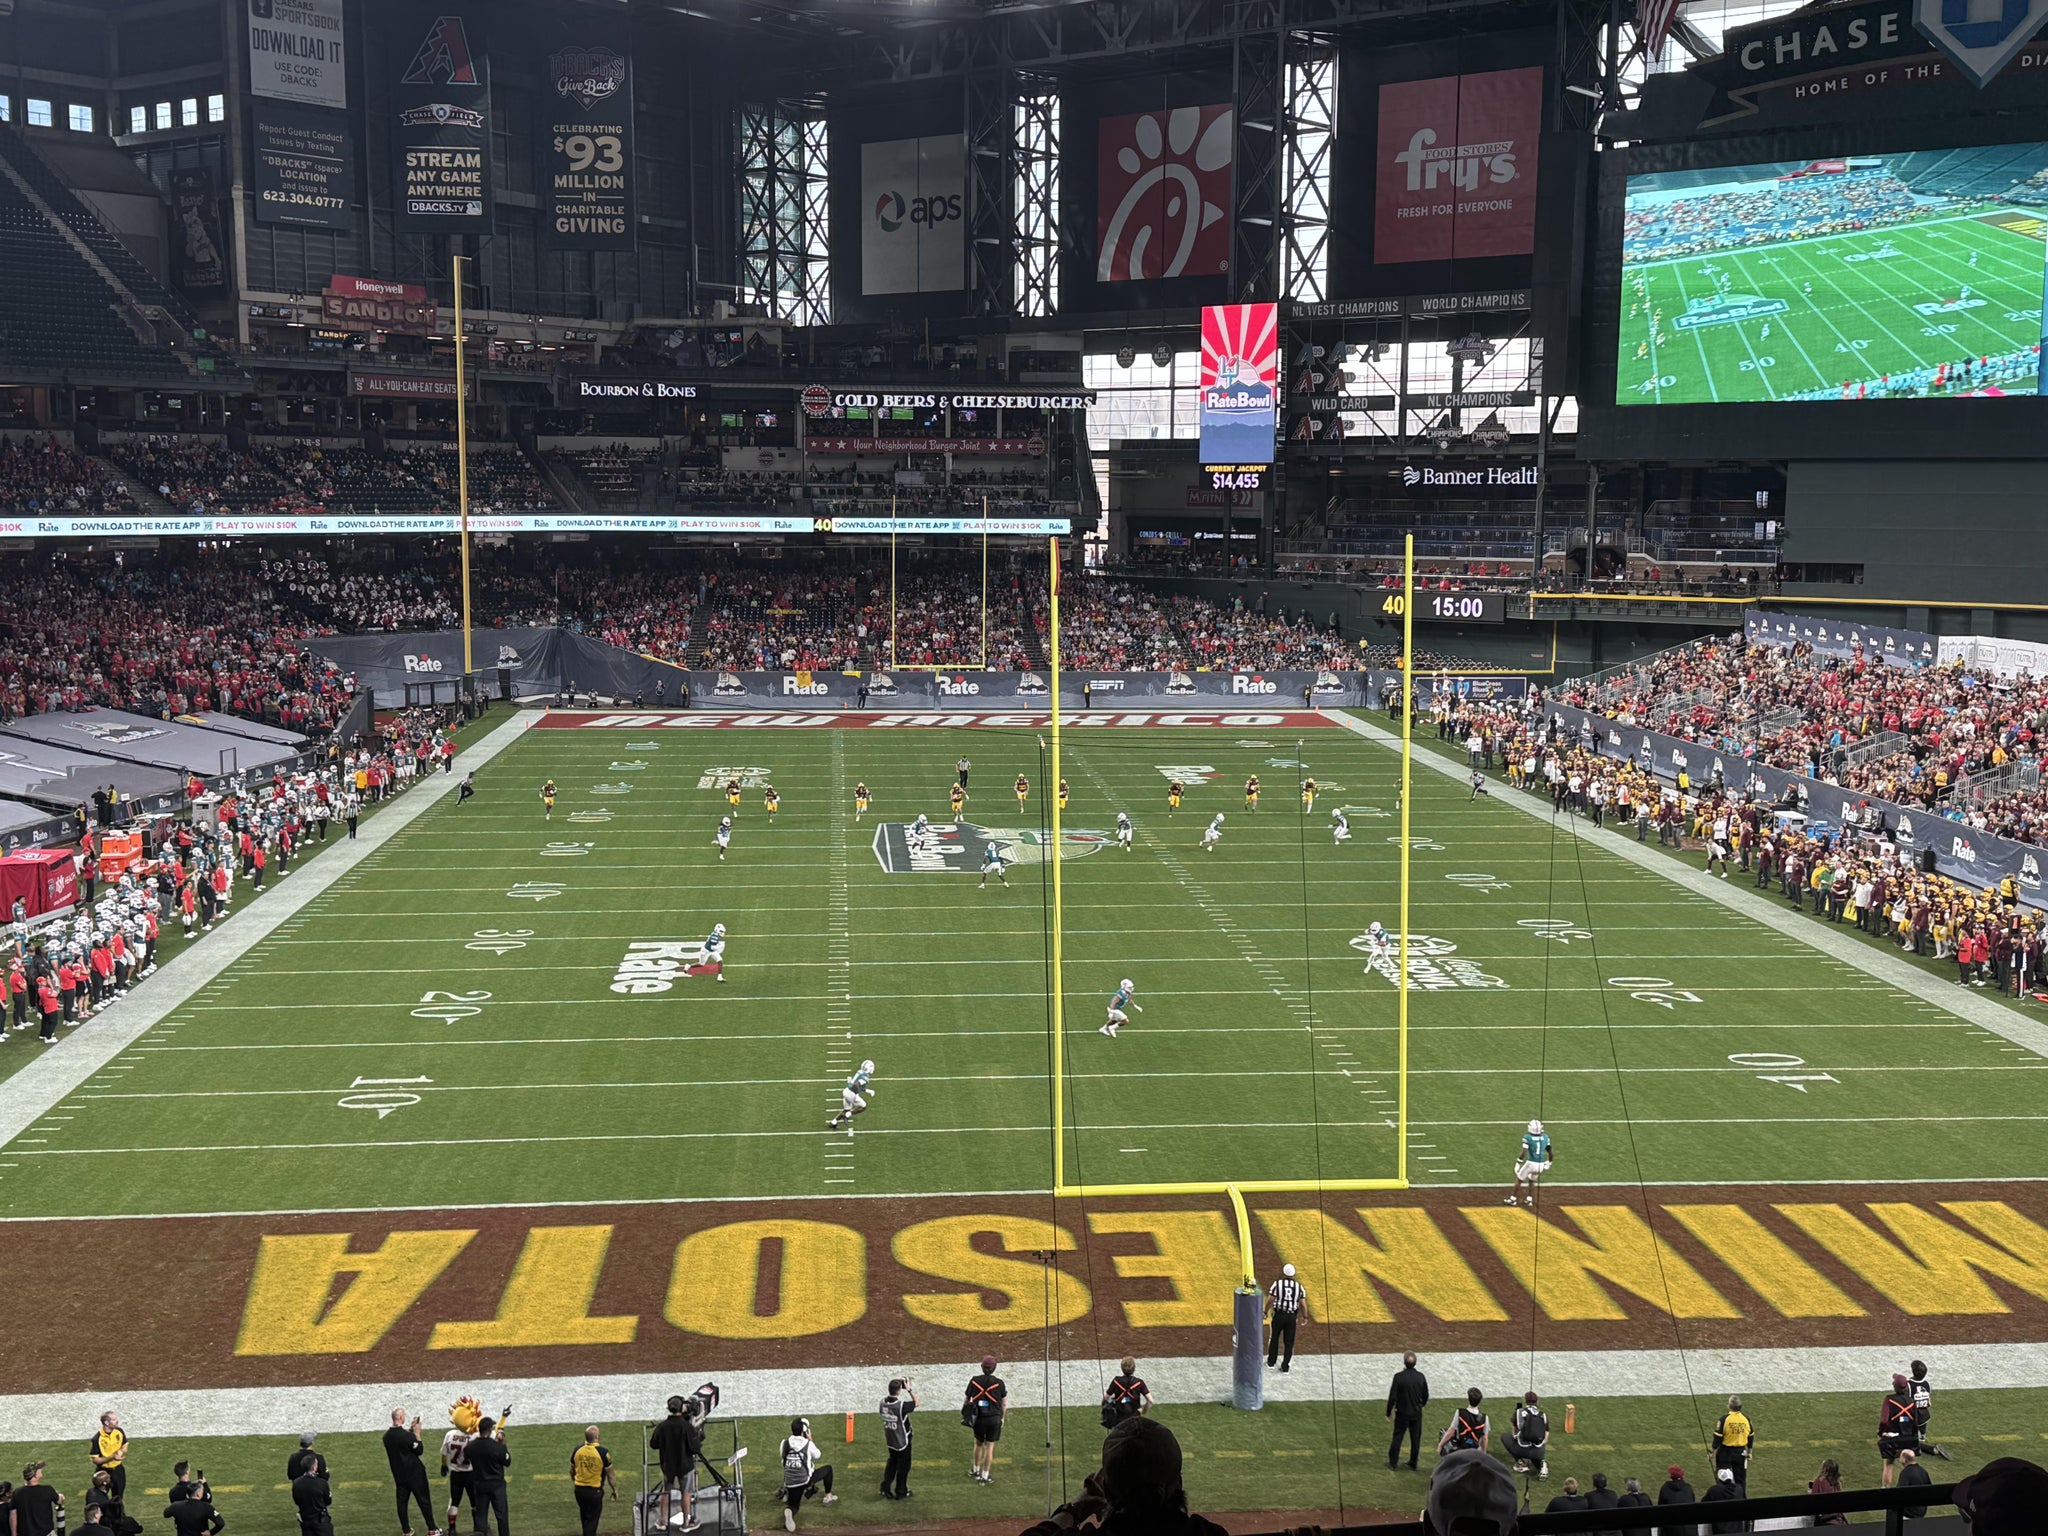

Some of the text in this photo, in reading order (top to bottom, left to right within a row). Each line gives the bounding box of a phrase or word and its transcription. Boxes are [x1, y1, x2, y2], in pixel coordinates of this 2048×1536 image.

[275, 7, 340, 32] SPORTSBOOK
[252, 27, 341, 63] DOWNLOAD IT
[1740, 12, 1900, 71] CHASE
[274, 61, 323, 78] USE CODE:
[280, 73, 318, 88] DBACKS
[557, 76, 618, 97] Give Back
[1795, 64, 1941, 98] HOME OF THE
[409, 111, 474, 120] CHASE FIELD
[259, 123, 343, 143] Report Guest Conduct
[552, 124, 623, 134] CELEBRATING
[269, 136, 335, 154] Issues by Texting
[1425, 143, 1509, 159] FOOD STORES
[406, 152, 481, 168] STREAM
[554, 135, 624, 172] $93
[1395, 128, 1517, 192] fry's
[279, 168, 327, 183] LOCATION
[407, 170, 482, 183] ANY GAME
[554, 174, 625, 189] MILLION
[282, 182, 296, 190] and
[319, 186, 328, 194] to
[407, 185, 482, 197] ANYWHERE
[263, 190, 345, 209] 623.304.0777
[582, 191, 596, 202] IN
[411, 202, 464, 213] DBACKS.TV
[555, 204, 625, 215] CHARITABLE
[910, 194, 962, 229] aps
[1397, 199, 1513, 218] FRESH FOR EVERYONE
[556, 217, 626, 234] GIVING
[355, 280, 404, 294] Honeywell
[1292, 301, 1399, 317] NL WEST CHAMPIONS
[1422, 293, 1525, 310] WORLD CHAMPIONS
[1738, 356, 1776, 371] 50
[369, 379, 433, 393] ALL-YOU-CAN-EAT
[434, 383, 457, 394] SEATS
[580, 382, 697, 398] BOURBON & BONES
[835, 394, 878, 407] COLD
[882, 394, 936, 408] BEERS
[939, 396, 949, 408] &
[952, 395, 1094, 409] CHEESEBURGERS
[1311, 397, 1369, 410] WILD CARD
[1427, 392, 1513, 407] NL CHAMPIONS
[1427, 429, 1463, 439] CHAMPIONS
[1472, 430, 1510, 442] CHAMPIONS
[853, 439, 981, 453] Your Neighborhood Burger Joint
[1205, 464, 1267, 473] CURRENT JACKPOT
[1212, 473, 1260, 491] $14,455
[1423, 468, 1483, 485] Banner
[38, 521, 59, 532] Rate
[71, 522, 132, 531] DOWNLOAD
[134, 522, 153, 530] THE
[155, 521, 181, 530] RATE
[182, 521, 200, 530] APP
[215, 521, 239, 530] PLAY
[240, 521, 254, 530] TO
[255, 520, 274, 529] WIN
[276, 520, 297, 529] $10K
[310, 520, 328, 530] Rate
[338, 520, 388, 528] DOWNLOAD
[389, 520, 405, 528] THE
[406, 520, 427, 528] RATE
[429, 520, 444, 528] APP
[455, 520, 476, 528] PAY
[477, 520, 487, 528] TO
[488, 520, 505, 528] WIN
[506, 520, 523, 528] $10K
[534, 519, 549, 528] Rate
[680, 520, 704, 528] PLAY
[706, 520, 718, 528] TO
[719, 520, 739, 528] WIN
[739, 520, 761, 528] $10K
[774, 520, 792, 529] Rate
[814, 519, 831, 531] 40
[835, 521, 888, 529] DOWNLOAD
[888, 521, 906, 529] THE
[907, 521, 932, 529] RATE
[932, 521, 950, 529] APP
[963, 522, 986, 530] PLAY
[988, 522, 1000, 530] TO
[1001, 522, 1020, 530] WIN
[1021, 522, 1042, 530] $10K
[1382, 595, 1405, 614] 40
[1432, 596, 1484, 618] 15:00
[403, 653, 443, 673] Rate
[783, 675, 829, 695] Rate
[937, 675, 979, 695] Rate
[1090, 680, 1125, 690] ESPN
[1233, 675, 1277, 694] Rate
[1564, 677, 1581, 688] 413
[1671, 748, 1688, 768] Rate
[33, 829, 48, 842] Rate
[1951, 836, 1976, 863] Rate
[1535, 1141, 1541, 1155] 1
[1284, 1287, 1293, 1301] R
